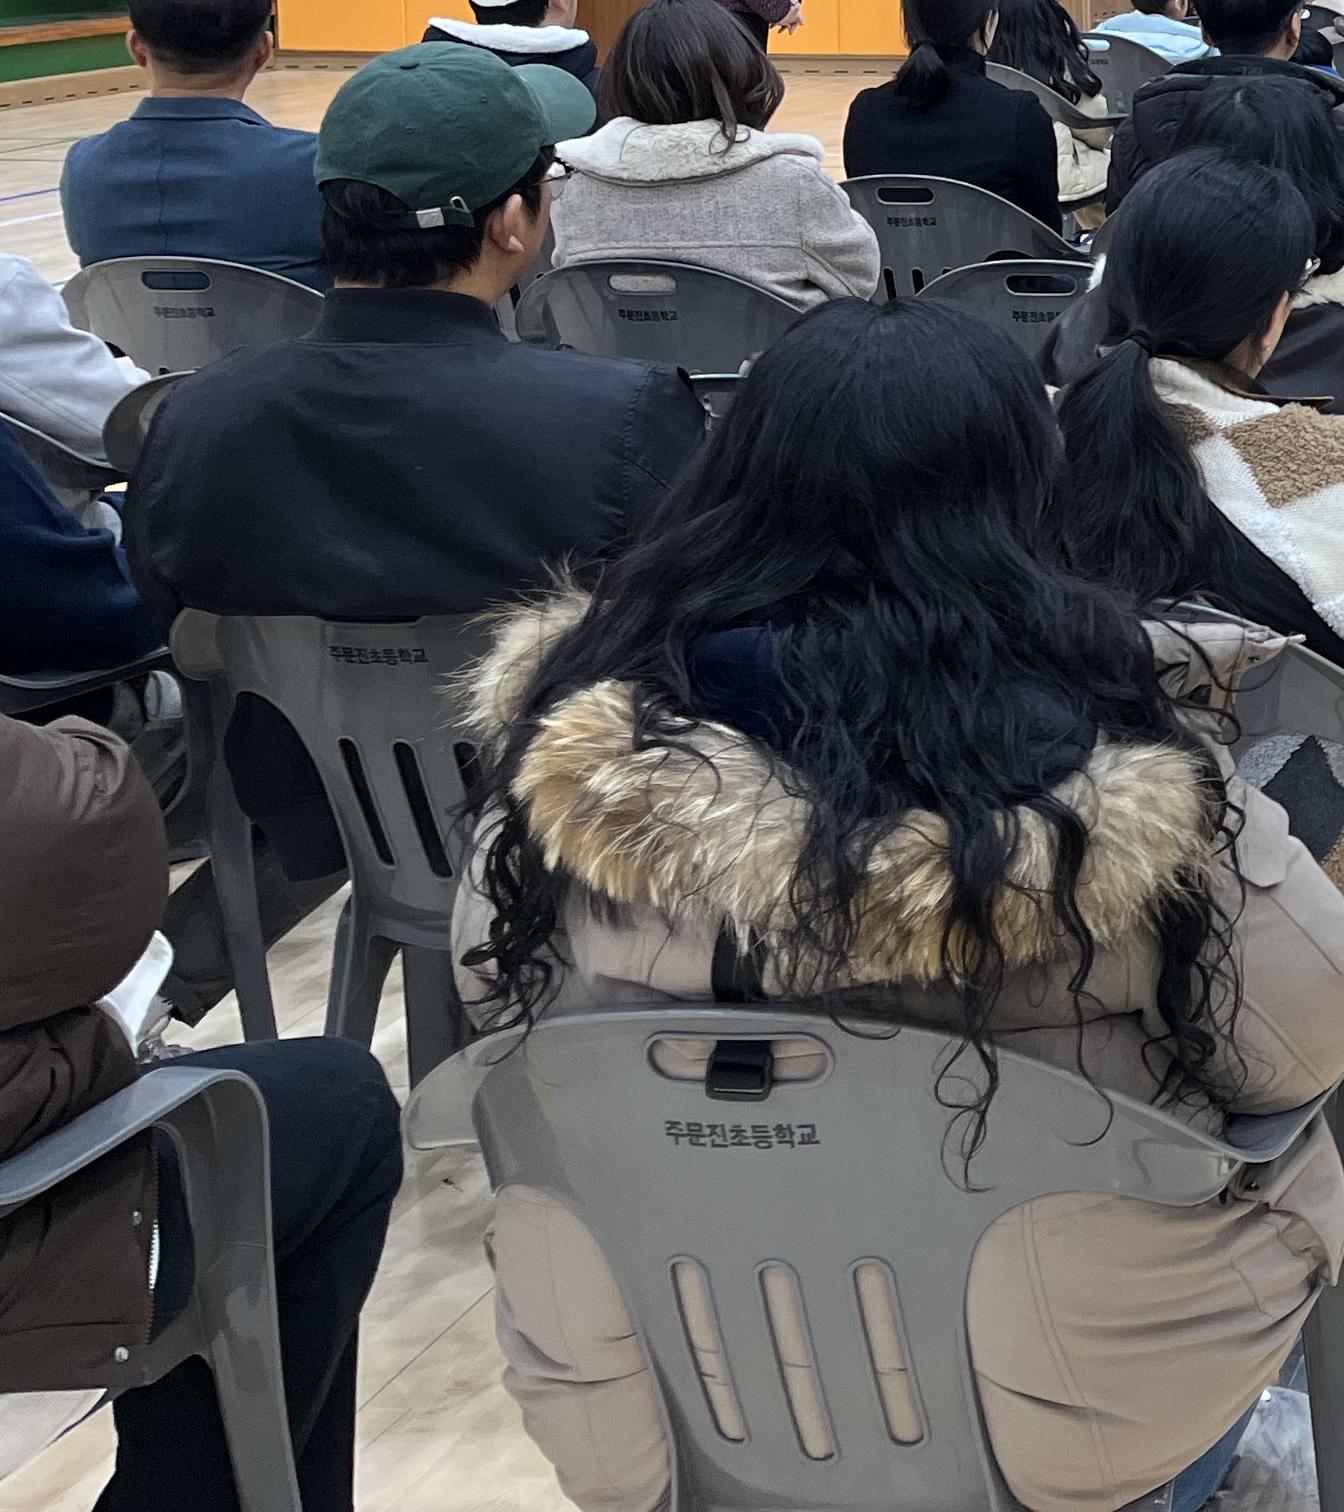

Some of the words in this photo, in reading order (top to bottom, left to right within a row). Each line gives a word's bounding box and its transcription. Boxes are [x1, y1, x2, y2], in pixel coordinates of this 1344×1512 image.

[618, 309, 679, 322] 주문진초등학교
[1012, 311, 1063, 323] 주문진초등
[330, 645, 429, 665] 주문진초등학교
[666, 1120, 820, 1149] 주문진초등학교
